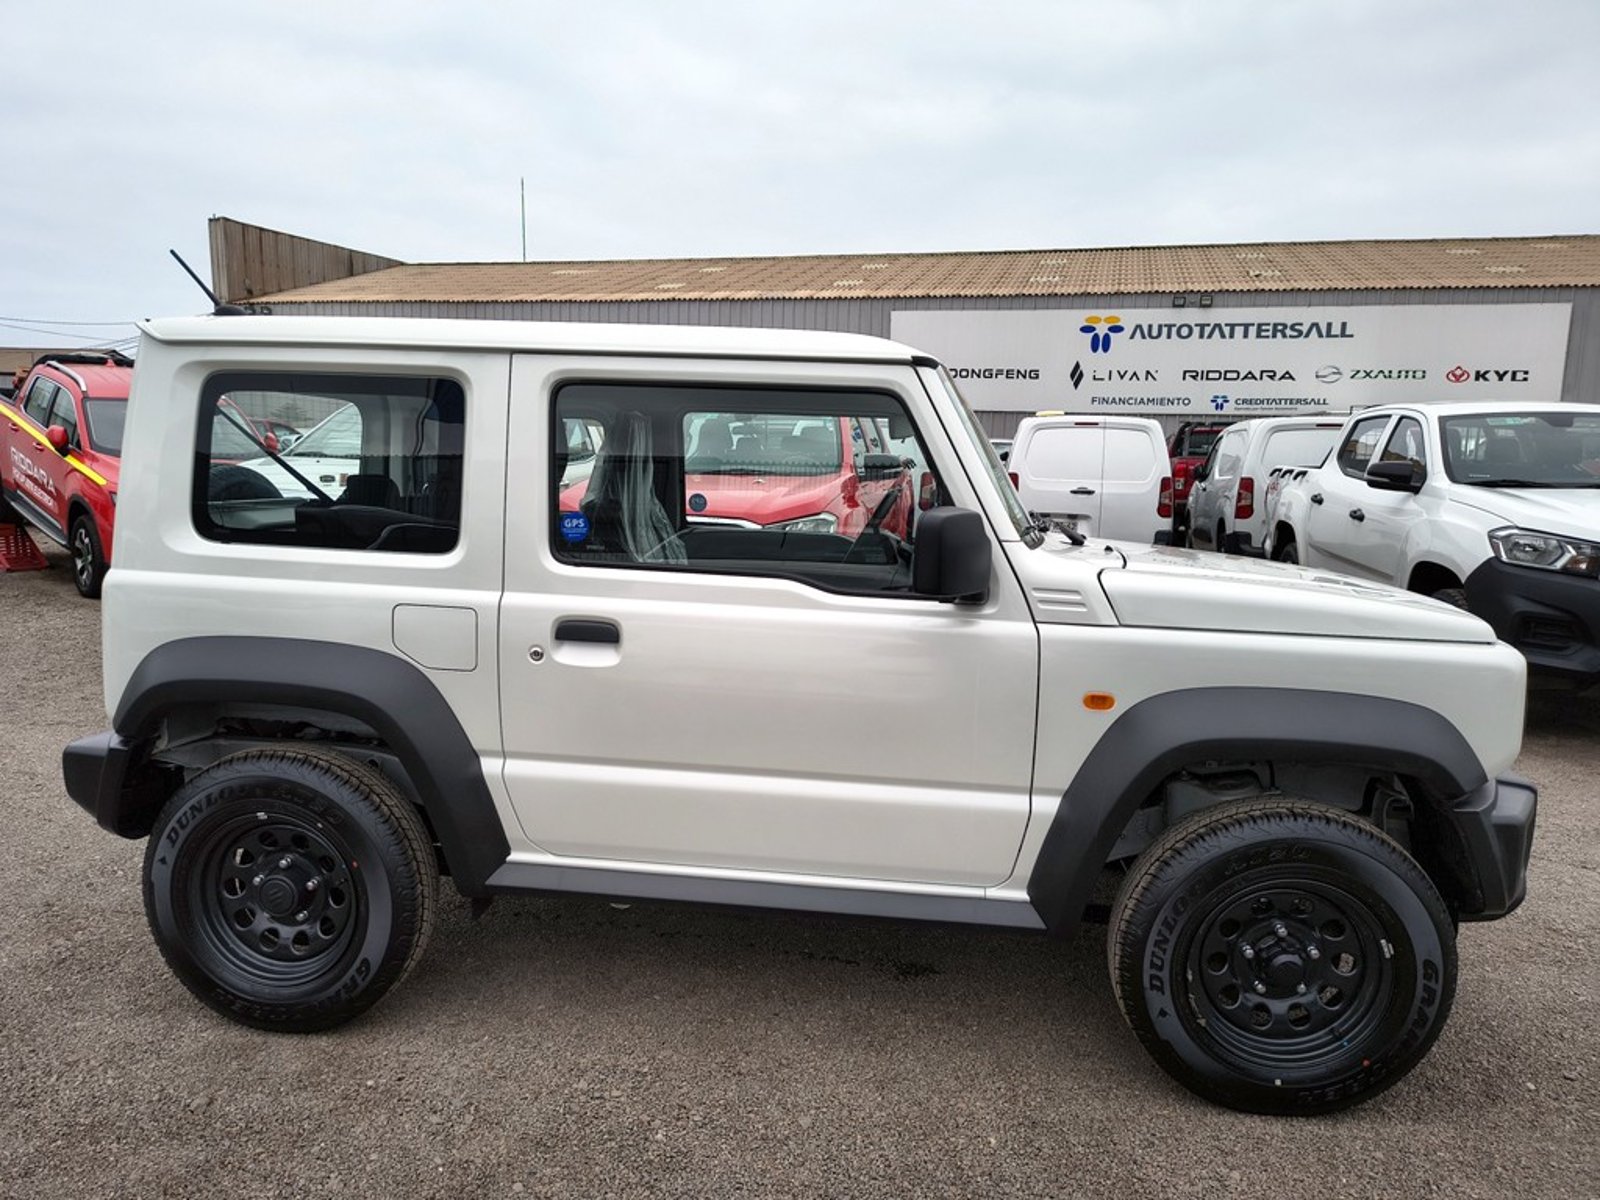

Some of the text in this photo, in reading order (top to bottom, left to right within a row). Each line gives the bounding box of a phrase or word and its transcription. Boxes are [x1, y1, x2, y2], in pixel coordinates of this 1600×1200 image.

[1129, 322, 1354, 339] AUTOTATTERSALL
[1092, 370, 1158, 381] LIVAN
[1182, 370, 1296, 381] RIDDARA
[1350, 370, 1427, 380] ZXAUTO
[1474, 370, 1529, 382] KYC
[1091, 396, 1192, 407] FINANCIAMIENTO
[1234, 397, 1329, 406] CREDITATTERSALL
[564, 518, 585, 528] GPS
